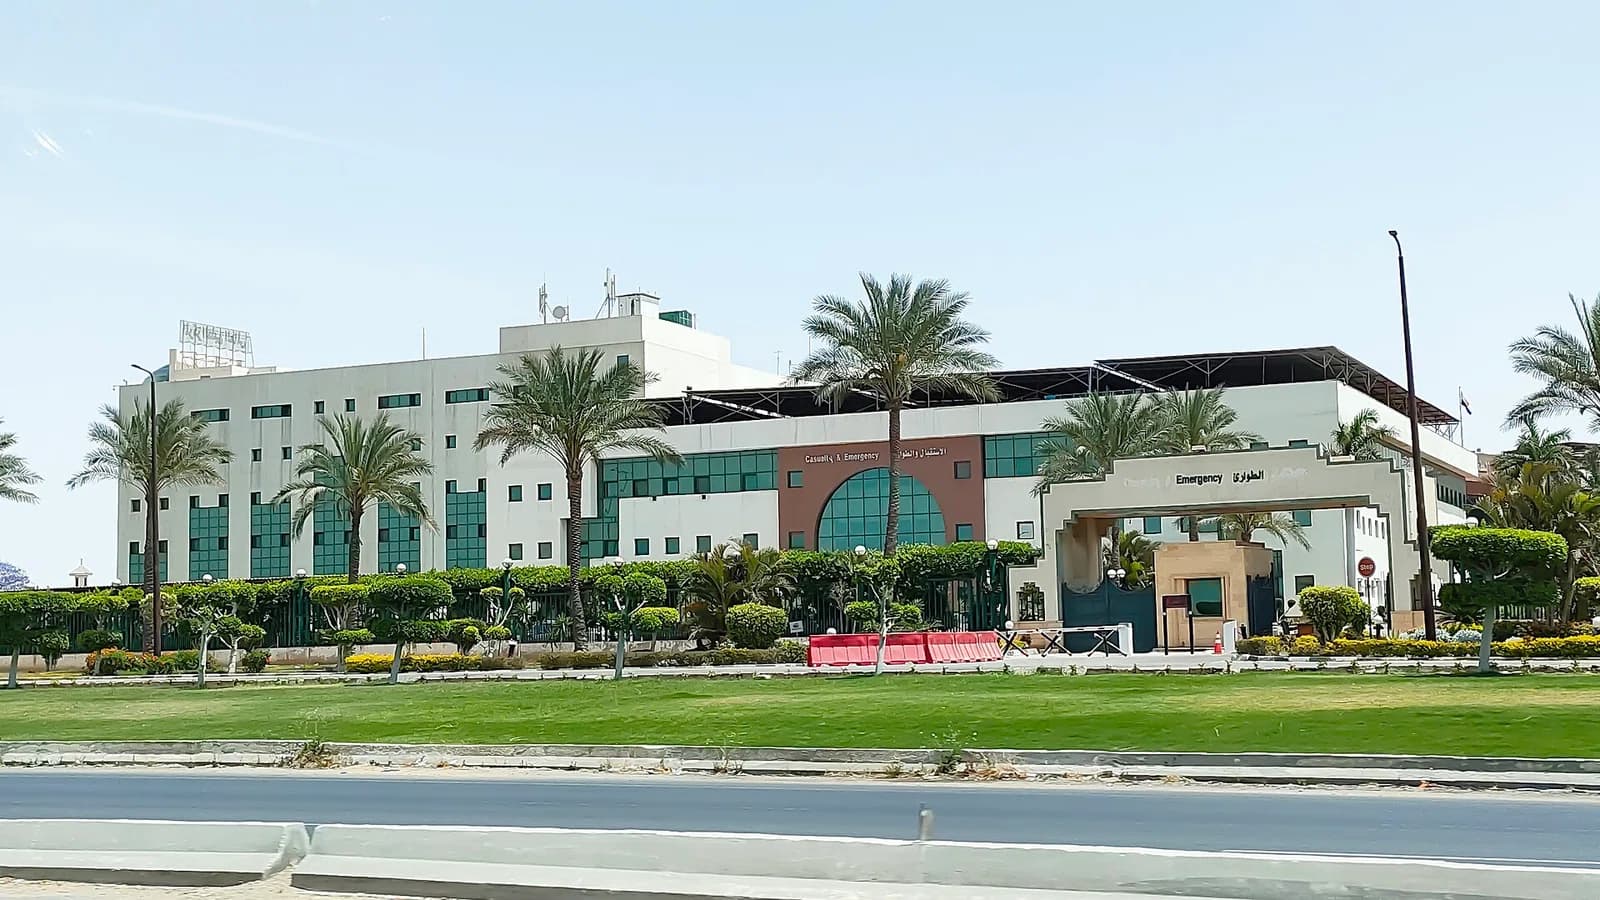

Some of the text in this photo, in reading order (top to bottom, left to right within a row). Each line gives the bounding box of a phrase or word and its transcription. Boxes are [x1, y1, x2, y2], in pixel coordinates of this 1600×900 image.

[804, 452, 880, 464] Casualty & Emergency
[919, 447, 947, 458] الاستقبال
[1176, 474, 1223, 486] Emergency
[1232, 470, 1264, 483] الطوارئ
